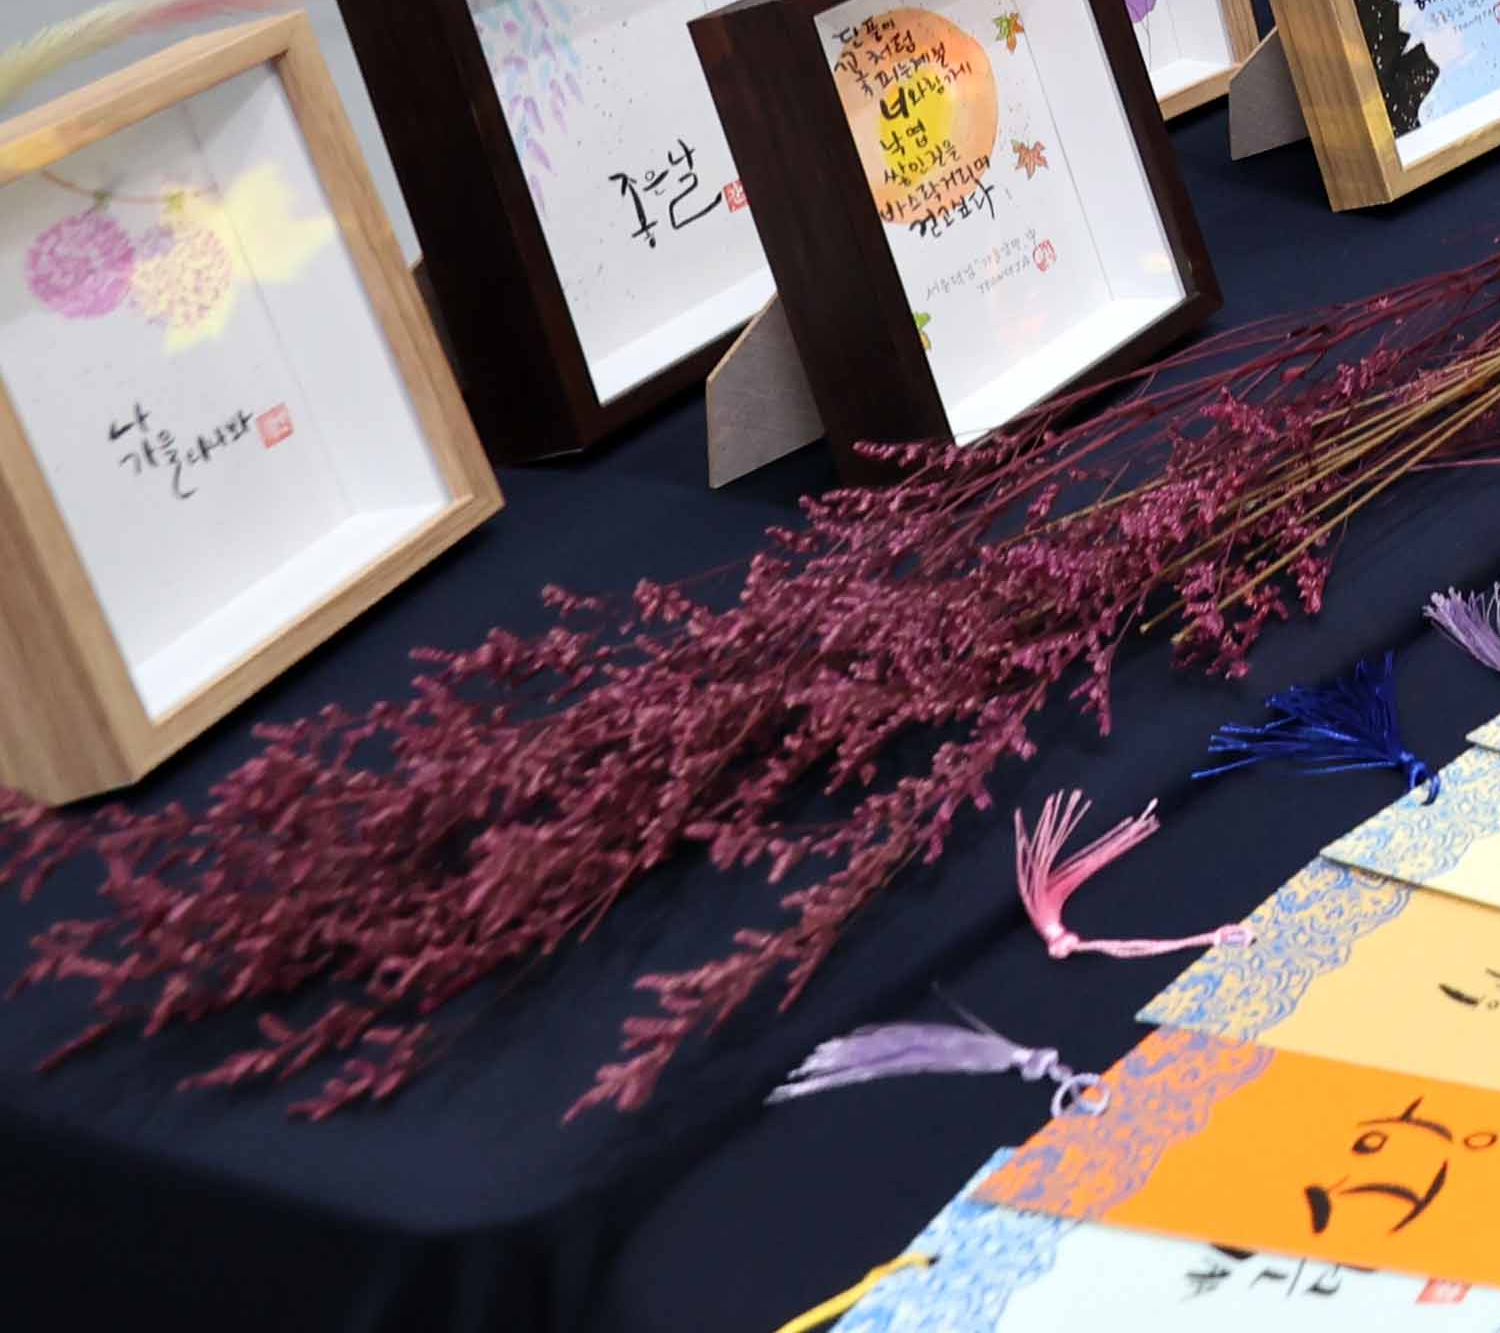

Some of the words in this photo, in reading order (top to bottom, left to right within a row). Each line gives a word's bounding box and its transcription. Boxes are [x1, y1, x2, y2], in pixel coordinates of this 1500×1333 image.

[831, 16, 895, 48] 단풍이
[880, 124, 926, 157] 낙엽
[108, 404, 151, 441] 나
[1305, 1097, 1498, 1234] 고양
